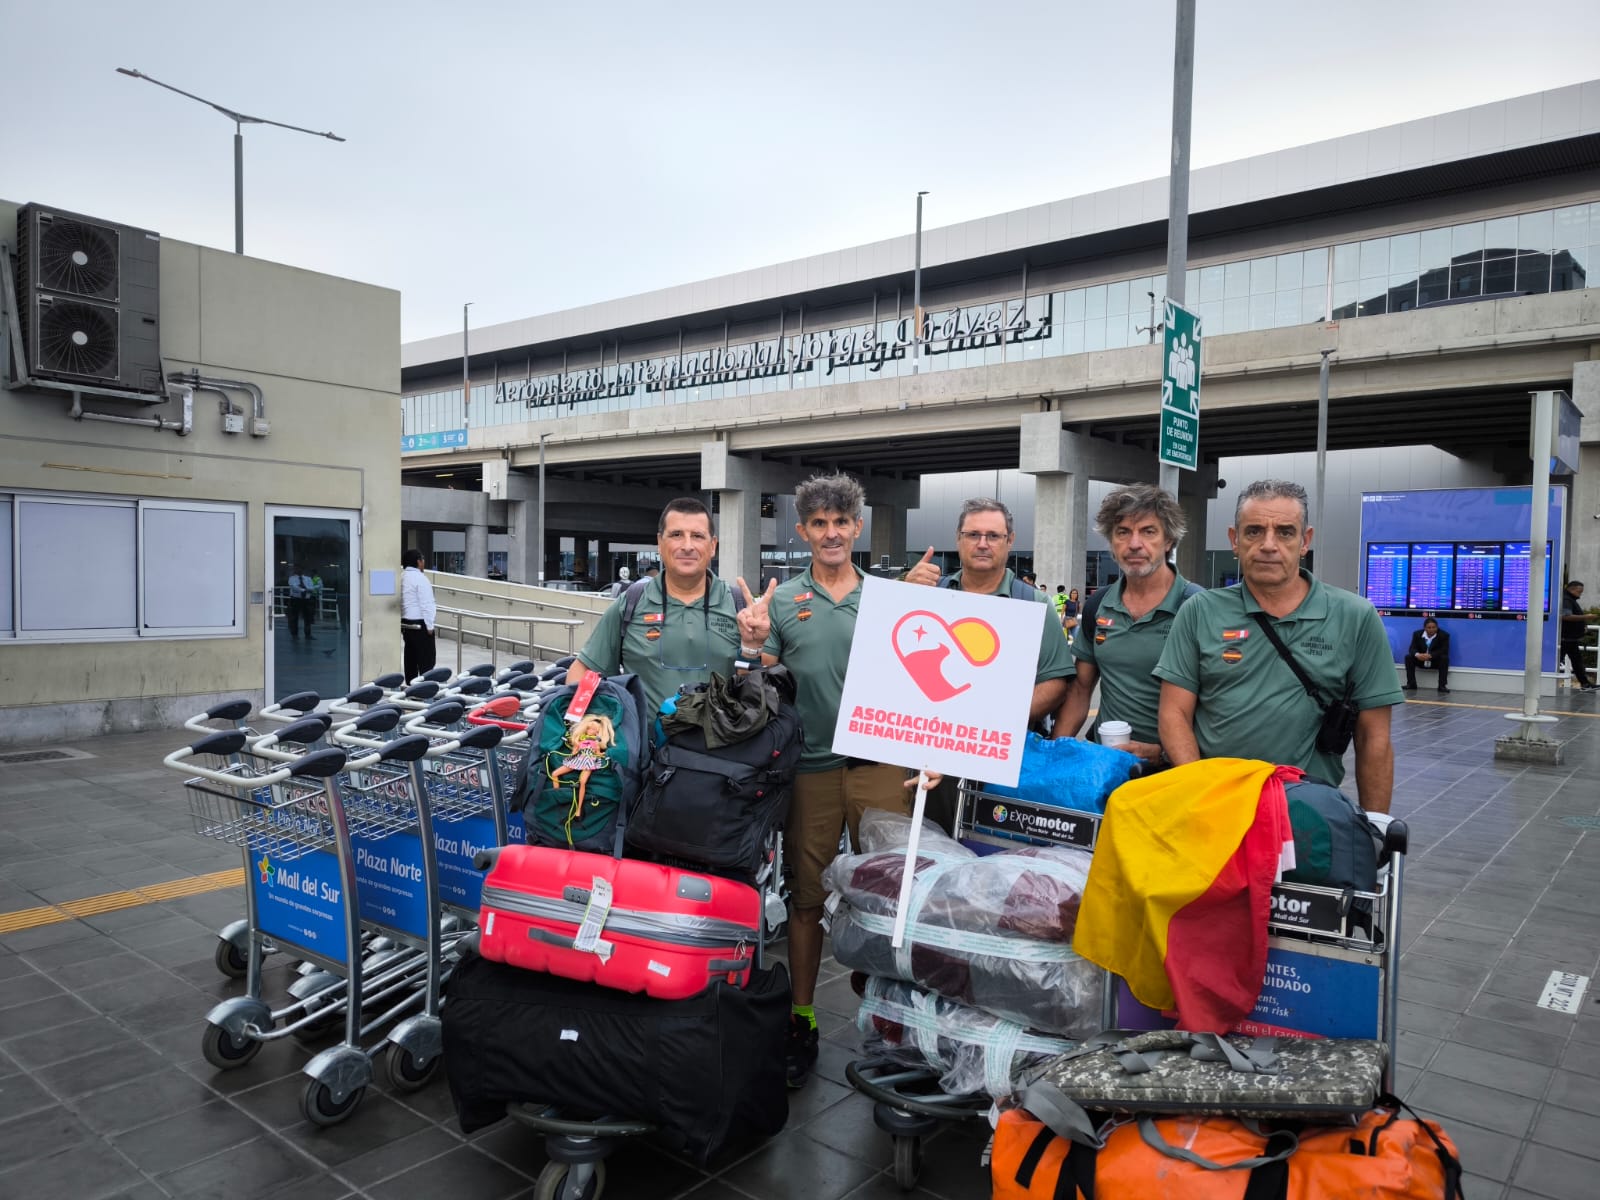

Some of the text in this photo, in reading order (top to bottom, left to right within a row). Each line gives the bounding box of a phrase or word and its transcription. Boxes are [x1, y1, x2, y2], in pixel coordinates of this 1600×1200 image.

[495, 304, 1025, 405] Aeropuerto Internacional Jorge Chávez
[1166, 426, 1174, 437] DE
[1173, 417, 1188, 430] PUNTO
[851, 705, 1012, 746] ASOCIACIÓN DE LAS
[848, 720, 1009, 761] BIENAVENTURANZAS
[1009, 809, 1076, 834] EXPOmotor
[434, 832, 457, 855] laza
[357, 847, 422, 882] Plaza Norte
[277, 867, 340, 904] Mall del Sur
[1298, 916, 1310, 924] Sur
[1266, 962, 1301, 980] NTES,
[1263, 975, 1311, 994] UIDADO
[1257, 994, 1280, 1006] ents,
[1255, 1004, 1289, 1017] wn risk
[1246, 1024, 1258, 1033] en
